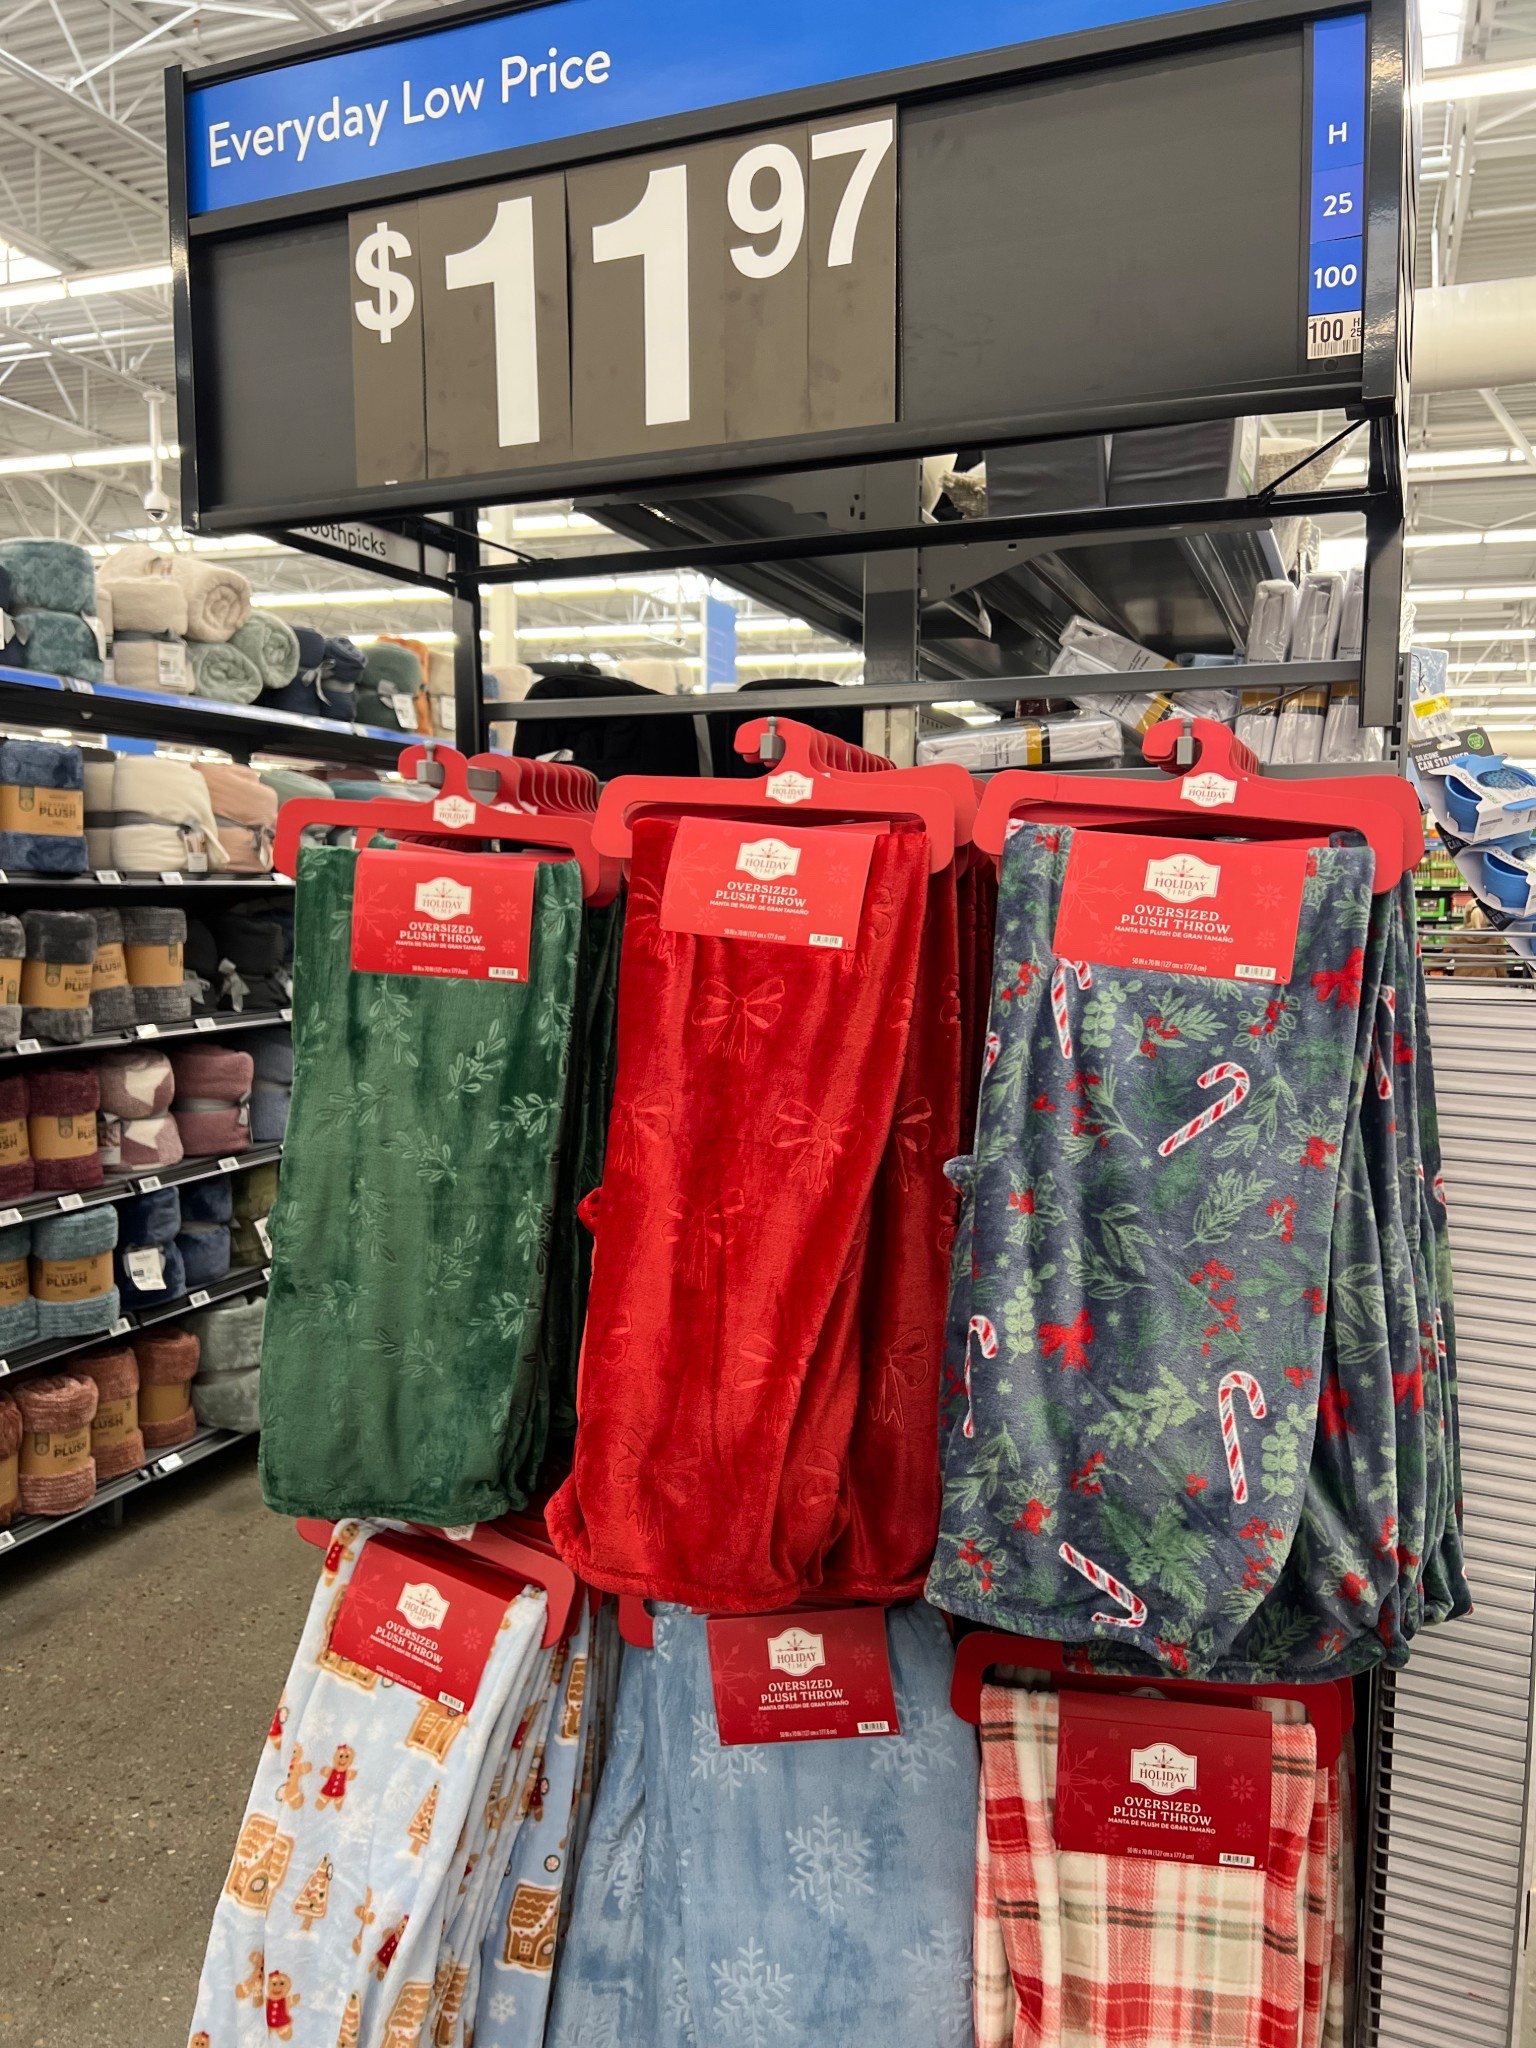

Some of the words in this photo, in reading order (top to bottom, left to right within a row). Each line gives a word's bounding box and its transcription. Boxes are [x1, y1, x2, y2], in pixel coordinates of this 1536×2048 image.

[208, 95, 389, 168] Everyday
[402, 76, 486, 126] Low
[500, 47, 611, 104] Price
[1328, 122, 1347, 144] H
[1322, 192, 1353, 217] 25
[1313, 263, 1358, 289] 100
[1309, 319, 1344, 343] 100
[1353, 317, 1360, 327] H
[1350, 327, 1362, 338] 25
[304, 524, 386, 556] oothpicks
[1415, 751, 1440, 763] SILICONE
[1417, 760, 1434, 772] CAN
[1188, 789, 1228, 799] HOLIDAY
[39, 807, 76, 819] PLUSH
[745, 857, 789, 871] HOLIDAY
[727, 881, 798, 896] OVERSIZED
[1155, 877, 1207, 891] HOLIDAY
[715, 890, 755, 903] PLUSH
[759, 894, 807, 908] THROW
[1166, 888, 1192, 897] TIME
[422, 898, 463, 910] HOLIDAY
[1134, 904, 1219, 921] OVERSIZED
[409, 921, 473, 935] OVERSIZED
[1121, 913, 1168, 928] PLUSH
[1173, 919, 1231, 935] THROW
[400, 930, 436, 942] PLUSH
[439, 933, 482, 944] THROW
[1114, 925, 1138, 933] MANTA
[1150, 929, 1171, 937] PLUSH
[1182, 932, 1202, 940] GRAN
[46, 1276, 88, 1288] PLUSH
[54, 1441, 87, 1458] PLUSH
[404, 1600, 437, 1621] HOLIDAY
[385, 1619, 439, 1652] OVERSIZED
[375, 1626, 406, 1648] PLUSH
[407, 1640, 443, 1664] THROW
[777, 1652, 817, 1664] HOLIDAY
[768, 1679, 833, 1692] OVERSIZED
[761, 1691, 797, 1704] PLUSH
[800, 1689, 844, 1702] THROW
[1139, 1768, 1187, 1783] HOLIDAY
[1151, 1780, 1175, 1789] TIME
[1124, 1796, 1201, 1814] OVERSIZED
[1108, 1817, 1130, 1825] MANTA
[1113, 1806, 1157, 1820] PLUSH
[1160, 1810, 1212, 1826] THROW
